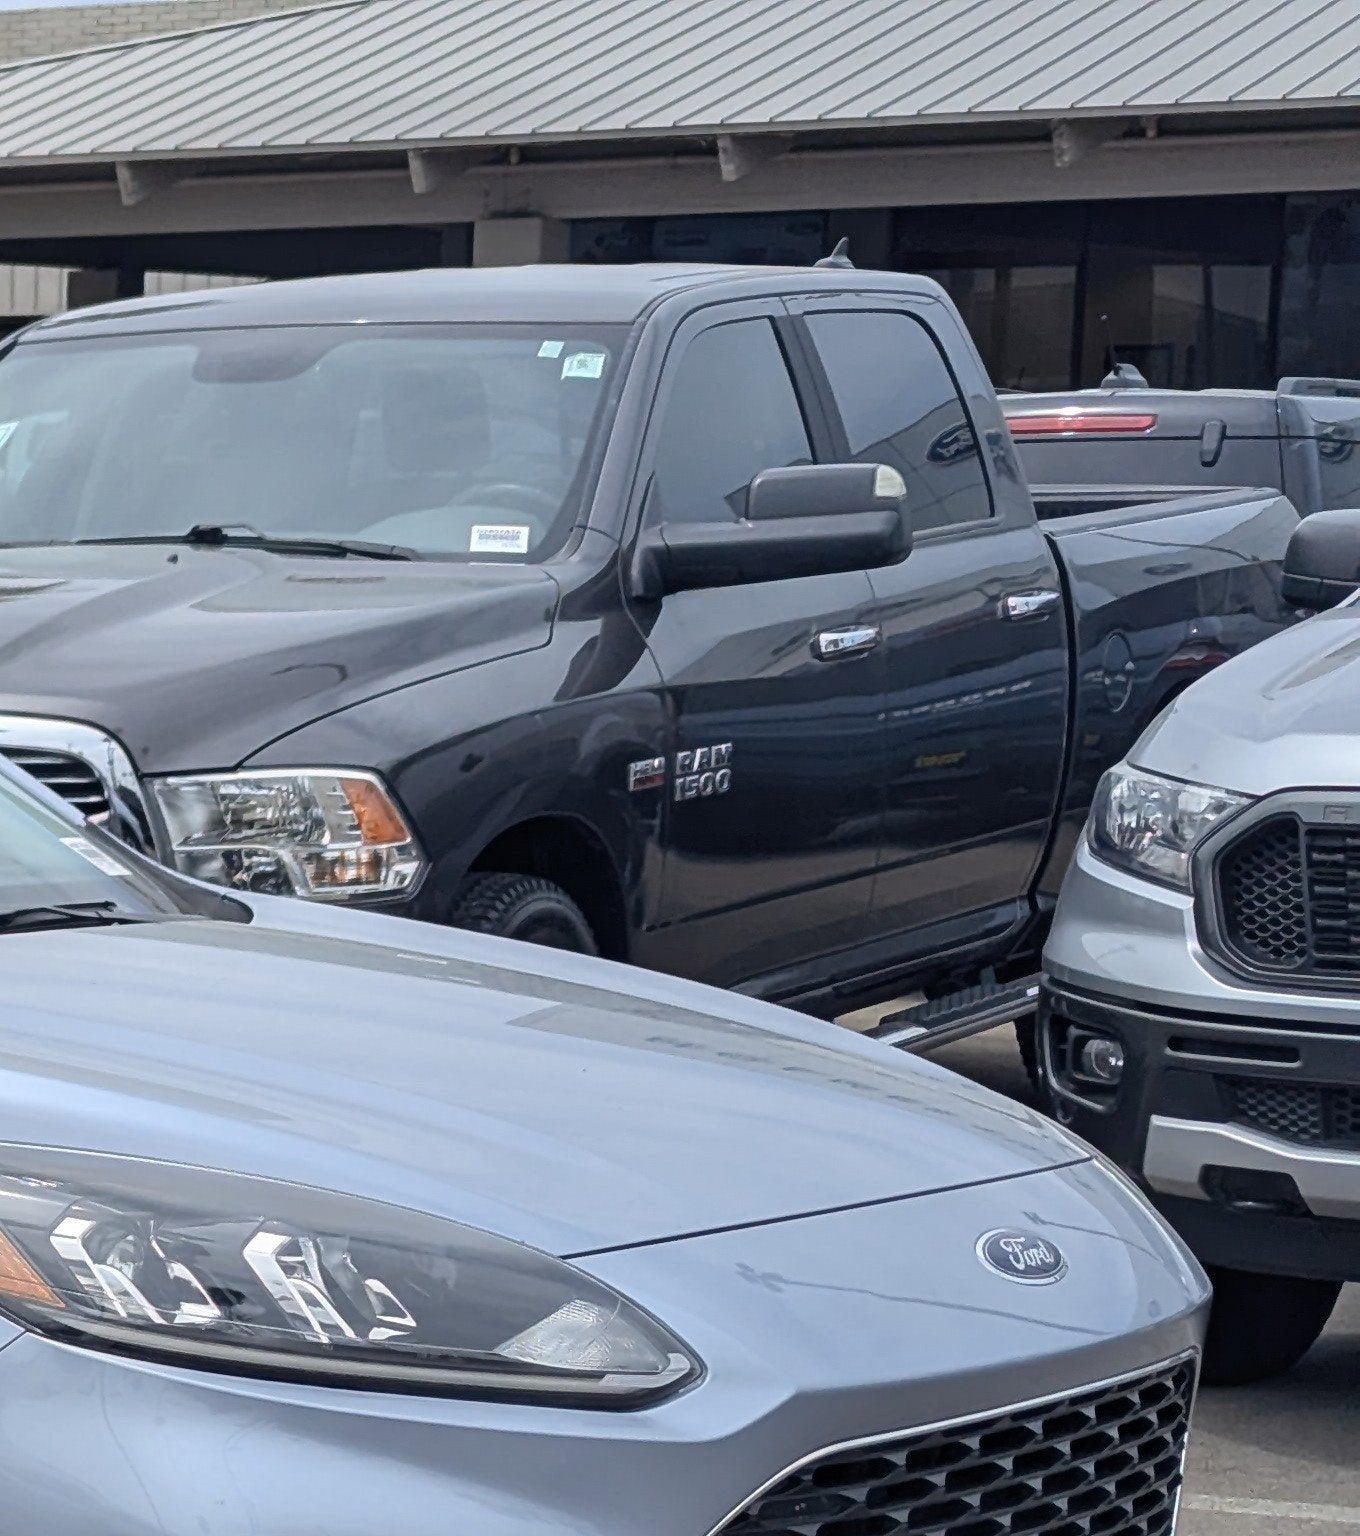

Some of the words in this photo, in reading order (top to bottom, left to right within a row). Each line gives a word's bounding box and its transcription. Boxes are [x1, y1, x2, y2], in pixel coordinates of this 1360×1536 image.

[675, 742, 733, 775] RAM
[674, 768, 732, 802] 1500
[998, 1236, 1055, 1271] Ford
